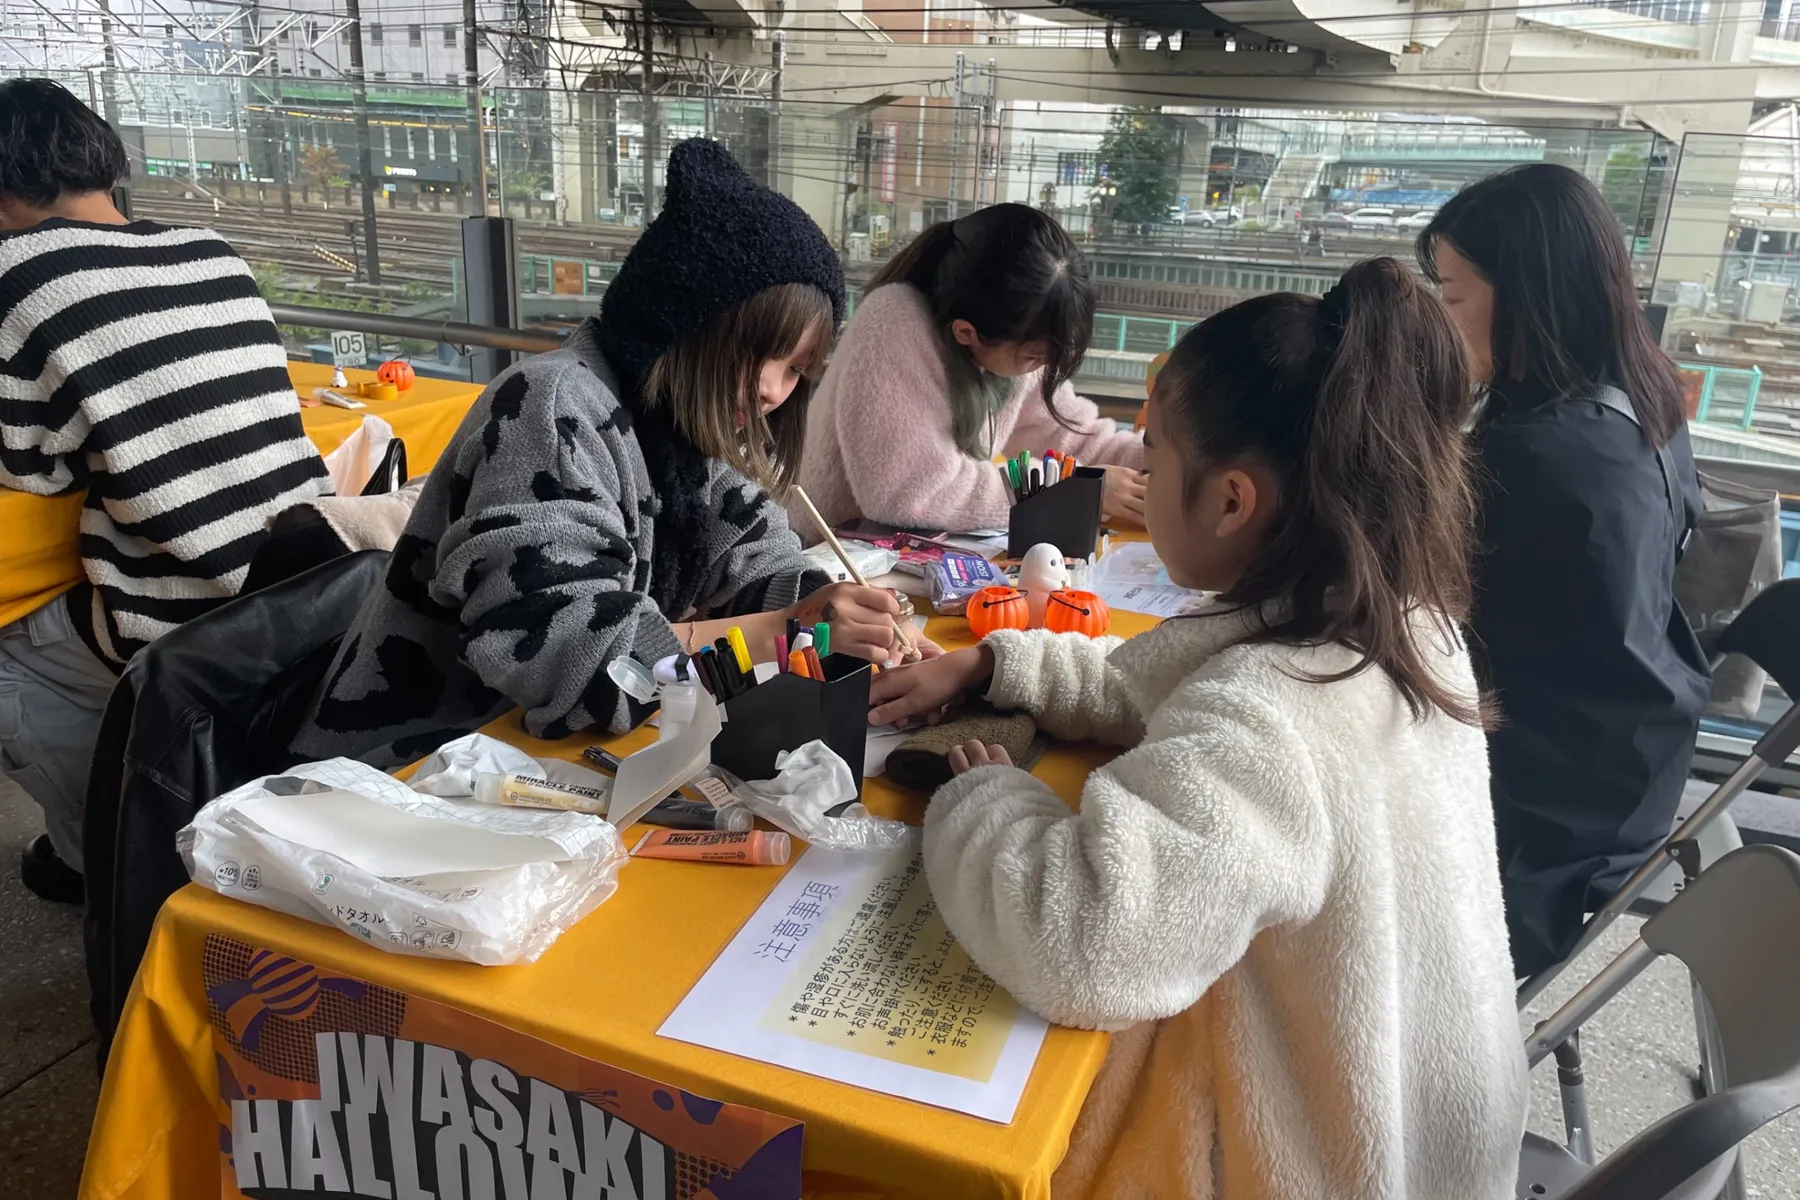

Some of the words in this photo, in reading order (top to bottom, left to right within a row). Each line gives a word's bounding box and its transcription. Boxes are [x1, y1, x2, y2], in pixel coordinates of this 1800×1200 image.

[334, 334, 362, 356] 105
[515, 774, 566, 790] MIRACLE
[569, 787, 602, 799] PAINT
[752, 880, 839, 961] 注意事項
[849, 894, 936, 1028] お肌に合わない時はすぐに落とし
[831, 923, 905, 1017] すぐに洗い流しください。
[872, 955, 927, 1029] お声掛けください。
[909, 973, 959, 1038] ご注意ください。
[931, 959, 980, 1044] 衣服などに付着す
[231, 1098, 630, 1200] HALLOW
[315, 1031, 666, 1200] IWASAKI
